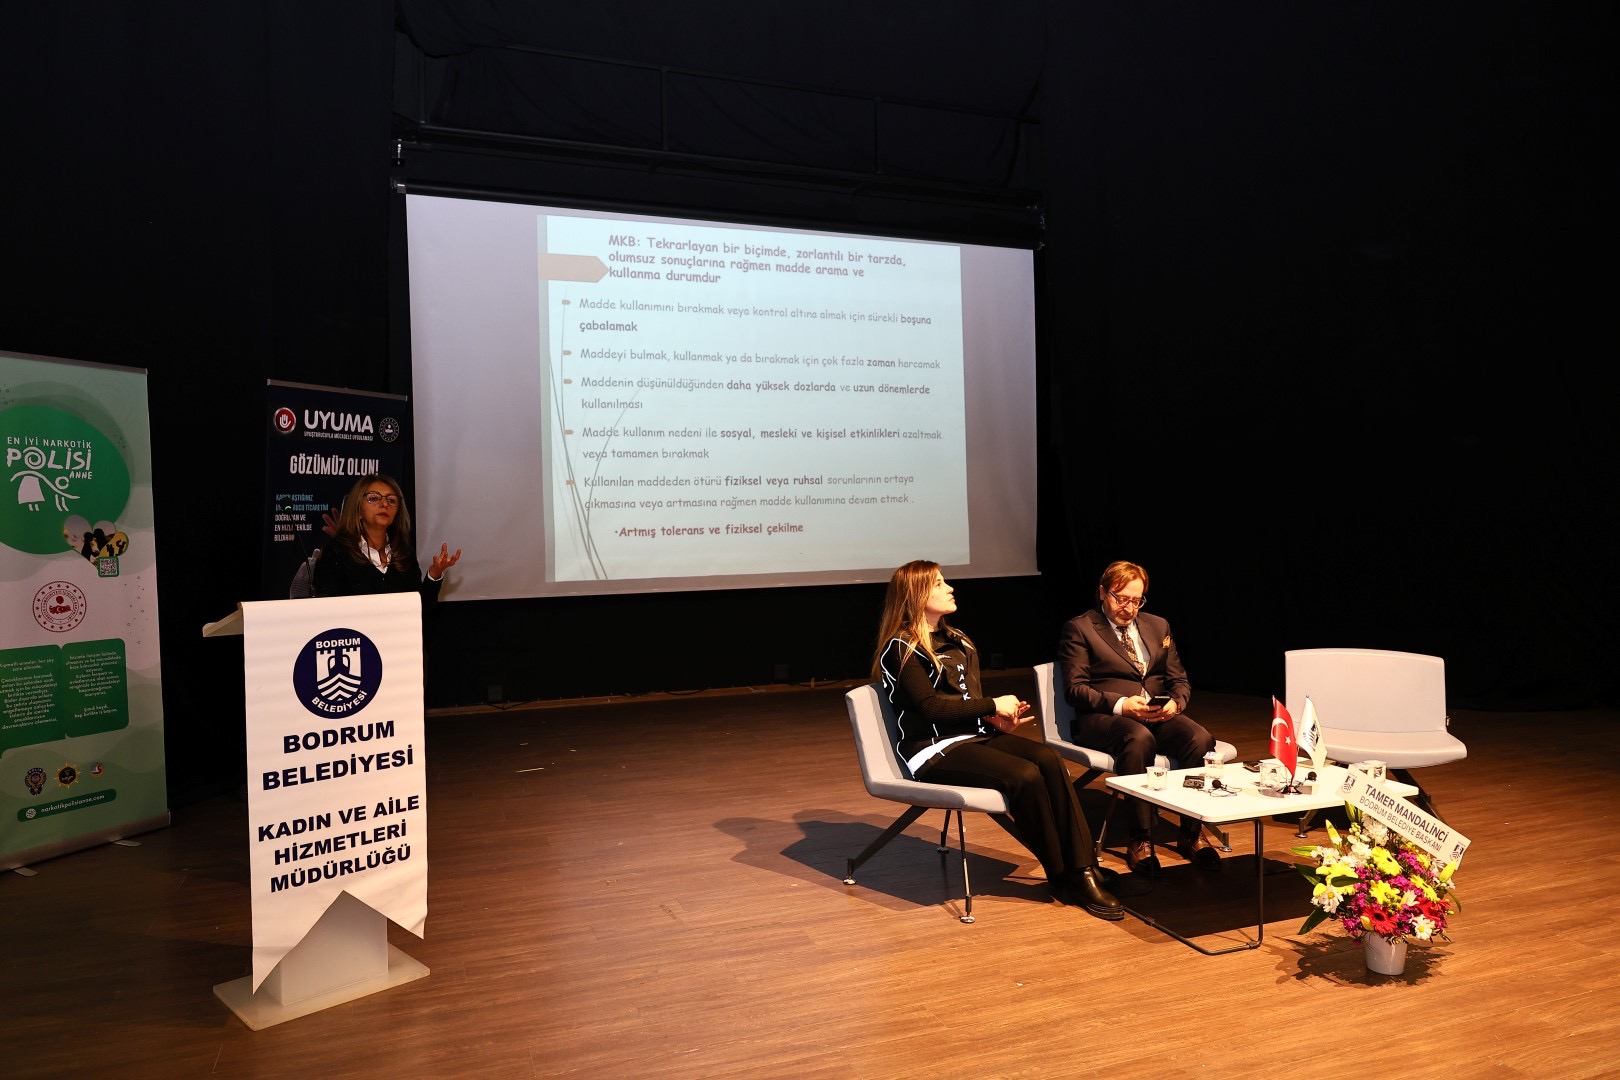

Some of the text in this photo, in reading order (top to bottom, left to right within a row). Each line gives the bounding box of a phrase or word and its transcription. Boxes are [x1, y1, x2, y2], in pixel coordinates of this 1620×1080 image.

[608, 234, 640, 247] MKB:
[646, 238, 718, 252] Tekrarlayan
[723, 242, 740, 254] bir
[744, 244, 790, 259] biçimde,
[848, 251, 864, 262] bir
[868, 254, 906, 267] tarzda,
[608, 250, 864, 277] olumsuz sonuçlarına rağmen madde arama ve
[608, 266, 721, 283] kullanma durumdur
[579, 298, 616, 309] Madde
[678, 302, 724, 314] bırakmak
[727, 308, 750, 318] veya
[753, 306, 787, 317] kontrol
[790, 308, 817, 318] altına
[820, 309, 846, 320] almak
[850, 312, 865, 322] için
[868, 312, 898, 322] sürekli
[901, 314, 931, 326] boşuna
[580, 320, 638, 332] çabalamak
[580, 348, 940, 369] Maddeyi bulmak, kullanmak ya da bırakmak için çok fazla zaman harcamak
[581, 376, 634, 387] Maddenin
[636, 377, 724, 393] düşünüldüğünden
[726, 380, 751, 390] daha
[756, 380, 790, 393] yüksek
[794, 381, 836, 392] dozlarda
[878, 384, 930, 394] dönemlerde
[582, 398, 642, 408] kullanılması
[304, 409, 374, 433] UYUMA
[25, 436, 38, 445] İYİ
[43, 439, 91, 448] NARKOTİK
[582, 427, 618, 438] Madde
[623, 426, 665, 438] kullanım
[668, 427, 702, 438] nedeni
[706, 427, 717, 438] ile
[720, 428, 755, 440] sosyal,
[760, 428, 797, 438] mesleki
[816, 428, 847, 440] kişisel
[850, 428, 900, 438] etkinlikleri
[902, 429, 942, 439] azaltmak
[7, 446, 92, 470] POLİSİ
[290, 452, 379, 476] GÖZÜMÜZ OLUN!
[582, 448, 709, 461] veya tamamen bırakmak
[70, 471, 92, 480] ANNE
[584, 474, 914, 488] Kullanılan maddeden ötürü fiziksel veya ruhsal sorunlarının ortaya
[639, 499, 663, 511] veya
[666, 498, 718, 508] artmasına
[720, 496, 757, 510] rağmen
[760, 496, 792, 506] madde
[794, 495, 846, 505] kullanımına
[848, 494, 877, 504] devam
[619, 526, 656, 538] Artmış
[660, 525, 704, 536] tolerans
[724, 523, 762, 535] fiziksel
[766, 522, 804, 536] çekilme
[316, 638, 361, 649] BODRUM
[312, 690, 368, 713] BELEDİYESİ
[283, 720, 395, 754] BODRUM
[262, 744, 414, 791] BELEDİYESİ
[41, 795, 105, 813] narkotikpolisianne.com
[1365, 784, 1449, 843] TAMER MANDALİNCİ
[258, 795, 420, 842] KADIN VE AİLE
[1359, 796, 1388, 818] BODRUM
[1415, 830, 1442, 852] BAŞKANI
[274, 819, 407, 865] HİZMETLERİ
[270, 845, 411, 892] MÜDÜRLÜĞÜ
